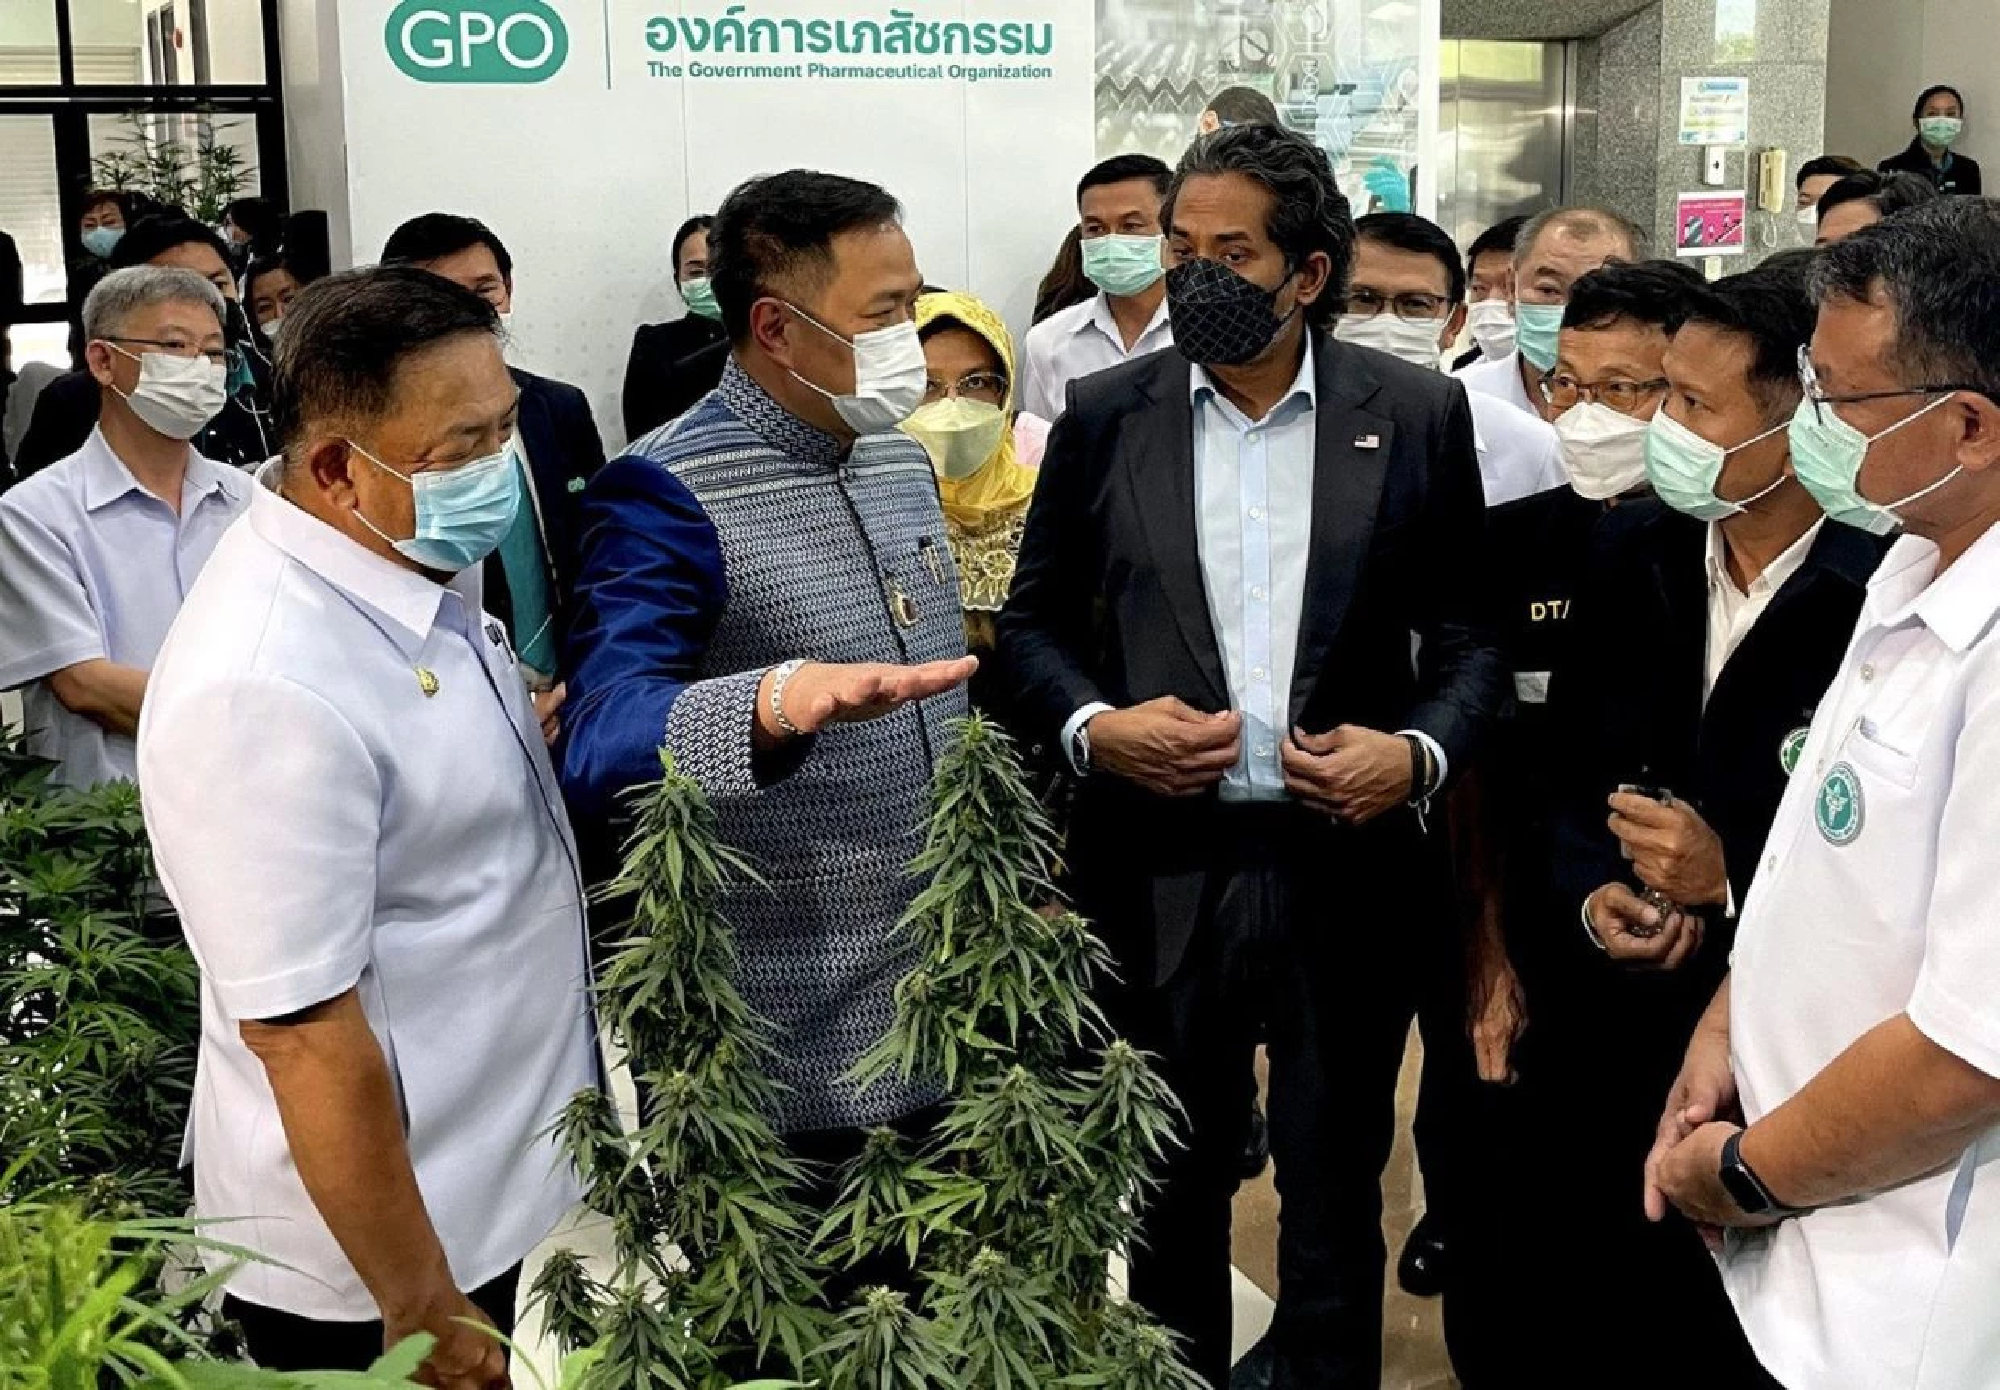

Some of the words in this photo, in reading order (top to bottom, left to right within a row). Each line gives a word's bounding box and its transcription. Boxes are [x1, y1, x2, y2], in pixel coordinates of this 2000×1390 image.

[401, 10, 554, 68] GPO
[645, 5, 1053, 54] องค์การเภสัชกรรม
[647, 60, 682, 77] The
[689, 60, 802, 77] Government
[808, 62, 943, 78] Pharmaceutical
[948, 64, 1053, 82] Organization
